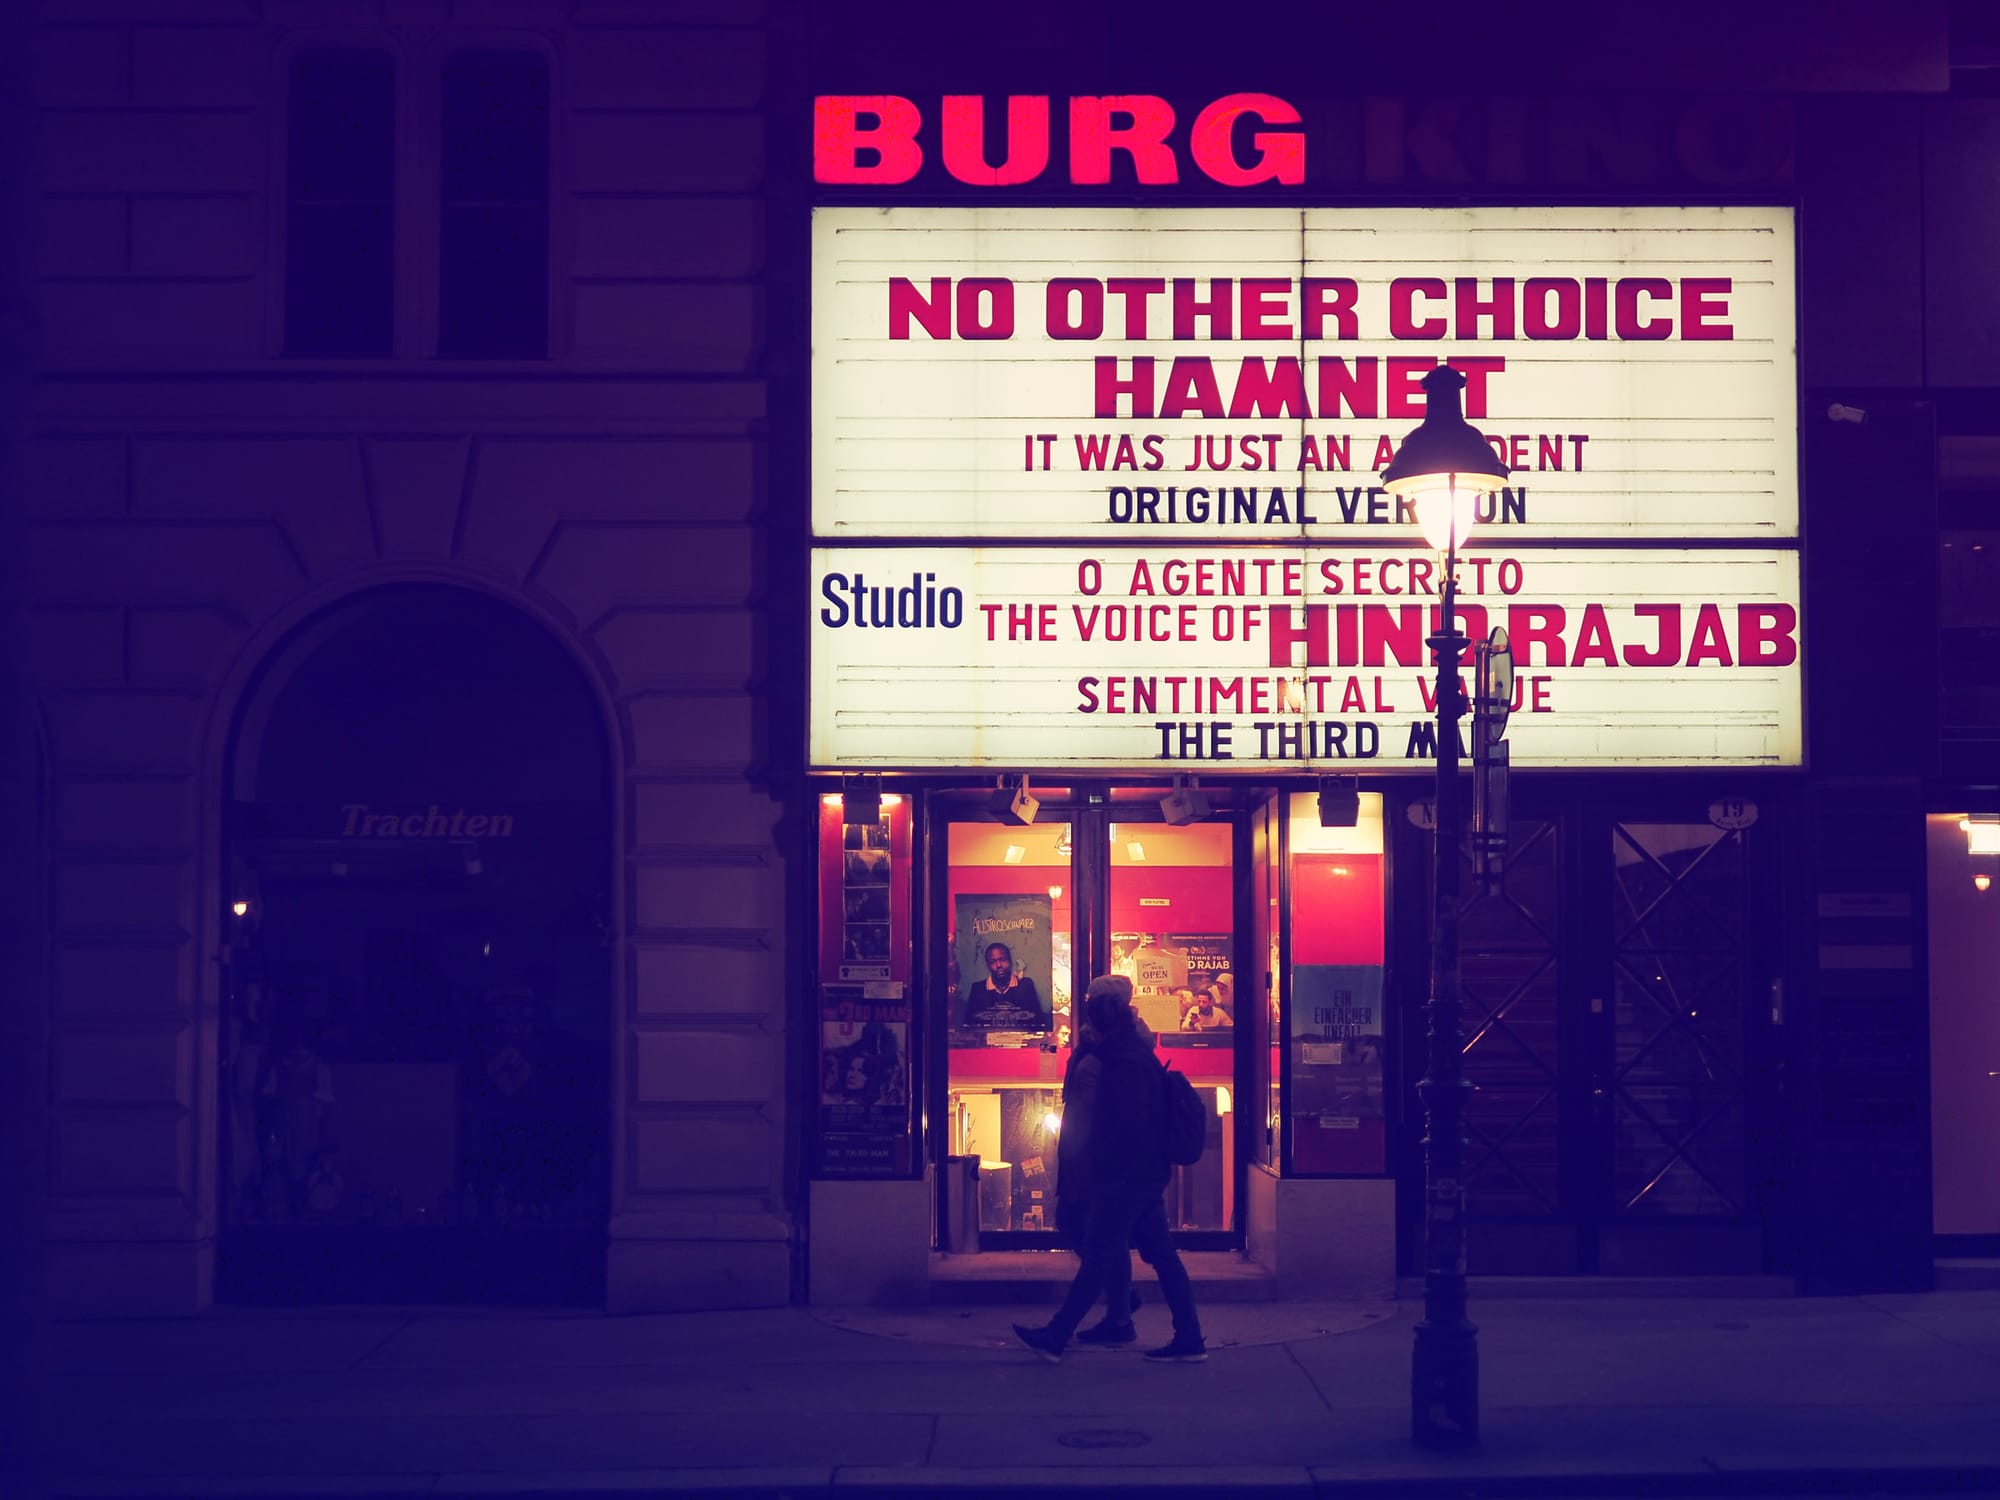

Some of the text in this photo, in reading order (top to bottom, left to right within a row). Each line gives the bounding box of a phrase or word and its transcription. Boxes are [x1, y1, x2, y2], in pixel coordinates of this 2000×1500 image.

[814, 94, 1306, 187] BURG
[889, 278, 1733, 341] NO OTHER CHOICE
[1095, 356, 1505, 418] HAMNET
[1025, 436, 1054, 471] IT
[1075, 436, 1163, 472] WAS
[1185, 435, 1282, 472] JUST
[1297, 435, 1350, 472] AN
[1109, 487, 1526, 524] ORIGINAL VERON
[1078, 559, 1102, 596] O
[1130, 559, 1301, 596] AGENTE
[821, 572, 963, 629] Studio
[980, 604, 1057, 641] THE
[1072, 605, 1197, 641] VOICE
[1212, 605, 1261, 642] OF
[1508, 603, 1797, 668] RAJAB
[1077, 677, 1394, 713] SENTIMENTAL
[1156, 722, 1232, 759] THE
[1253, 721, 1379, 758] THIRD
[341, 803, 513, 838] Trachten
[1723, 800, 1744, 818] 19
[1142, 970, 1168, 979] OPEN
[1197, 961, 1230, 970] RAJAB
[1314, 1007, 1372, 1025] EINFACHER
[1334, 990, 1353, 1007] EIN
